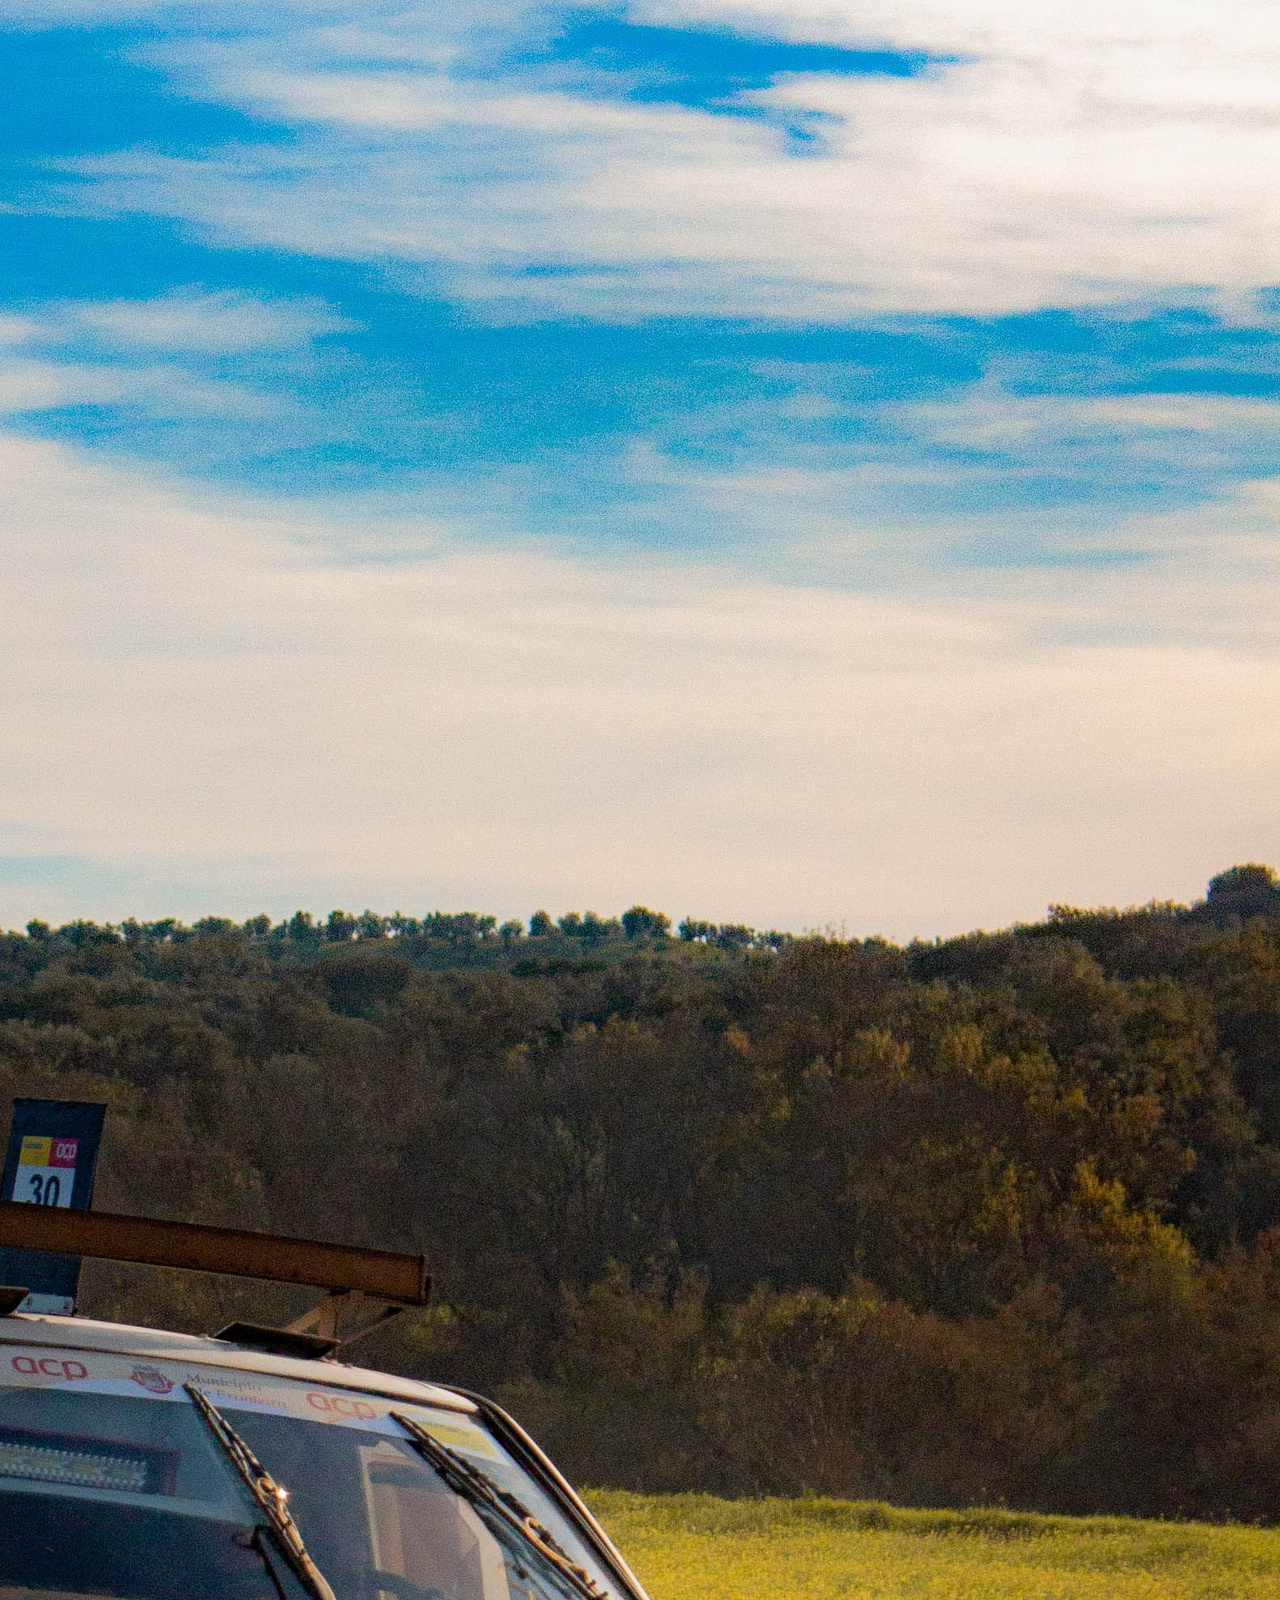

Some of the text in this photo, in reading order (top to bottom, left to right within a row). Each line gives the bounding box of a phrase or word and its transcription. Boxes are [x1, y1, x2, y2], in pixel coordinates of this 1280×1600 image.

[56, 1143, 78, 1162] acp
[29, 1173, 61, 1206] 30
[10, 1354, 89, 1382] acp
[306, 1391, 378, 1422] acp
